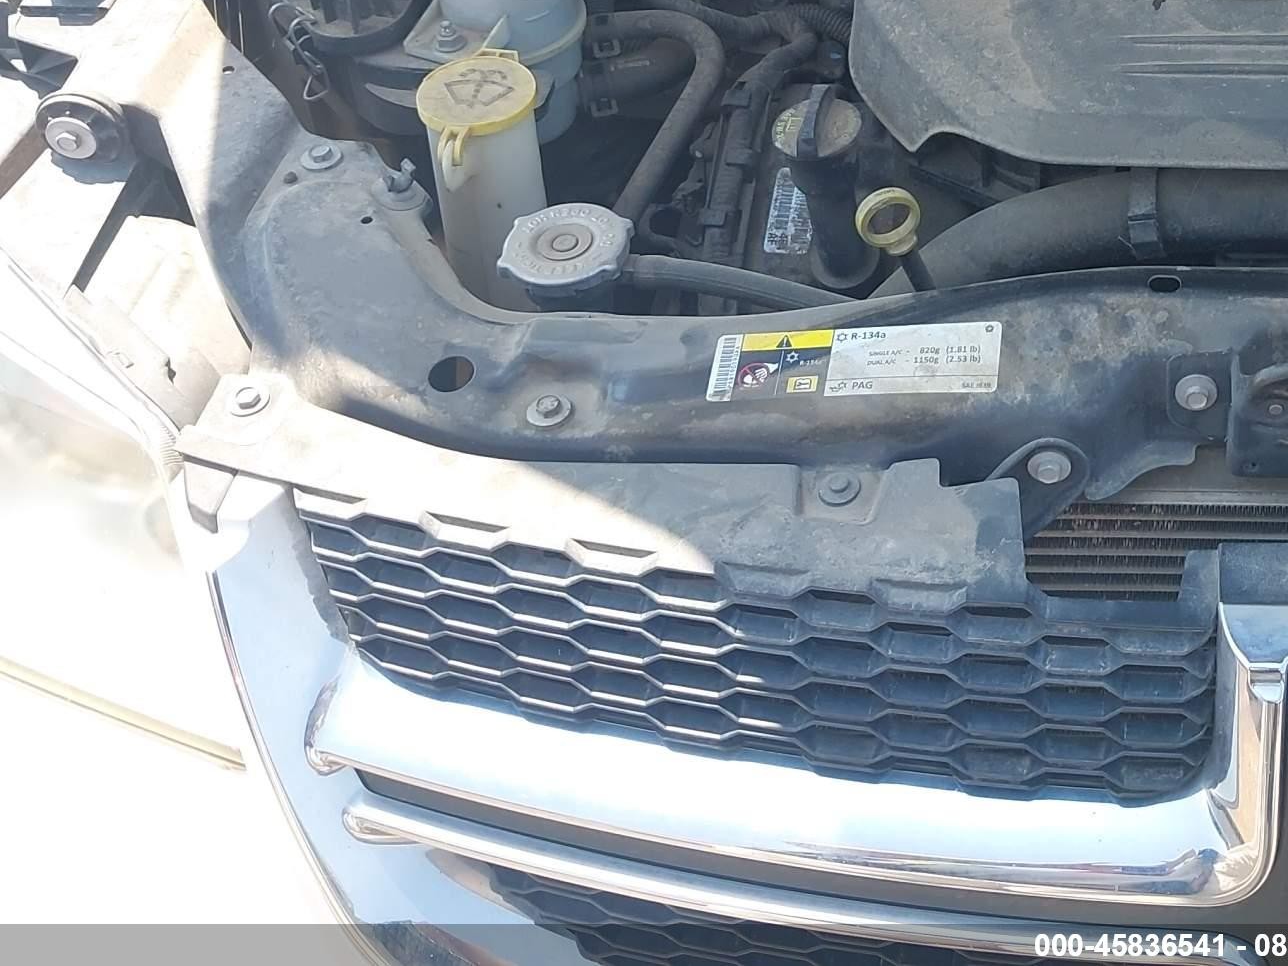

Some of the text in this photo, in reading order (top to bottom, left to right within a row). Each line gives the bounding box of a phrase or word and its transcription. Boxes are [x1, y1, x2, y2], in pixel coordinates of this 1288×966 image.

[850, 331, 887, 340] R-134a
[919, 346, 940, 355] 820g
[969, 345, 981, 354] lb)
[912, 356, 939, 365] 1150g
[969, 354, 981, 364] lb)
[851, 380, 873, 390] PAG
